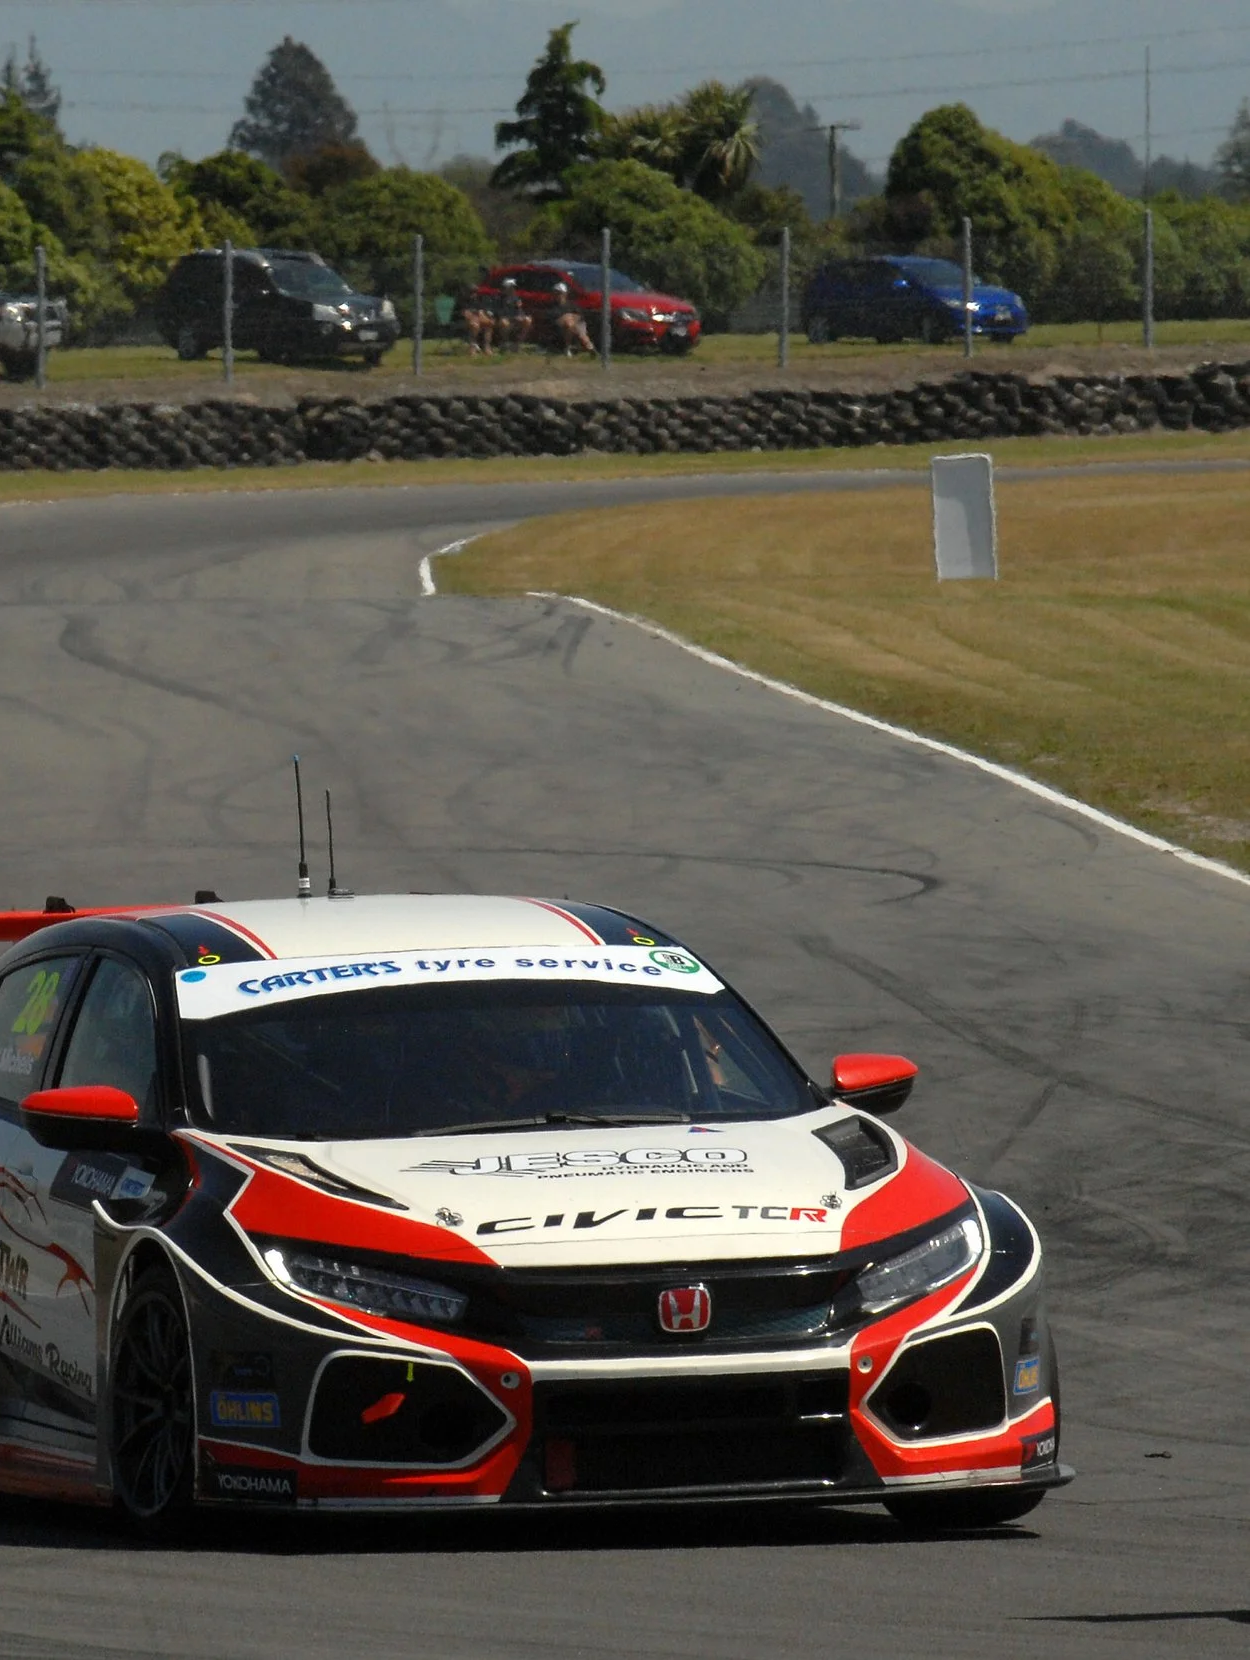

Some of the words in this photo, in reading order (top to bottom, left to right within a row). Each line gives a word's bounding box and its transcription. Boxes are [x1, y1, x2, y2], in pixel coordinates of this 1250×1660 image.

[237, 960, 402, 996] CARTER'S
[414, 957, 496, 972] tyre
[516, 957, 662, 977] service
[11, 969, 61, 1036] 28
[450, 1147, 748, 1175] JESCO
[536, 1170, 645, 1181] PNEUMATIC
[601, 1163, 704, 1171] HYDRAULIC
[476, 1206, 724, 1235] CIVIC
[731, 1205, 828, 1223] TCR
[45, 1342, 94, 1396] Racing
[218, 1474, 293, 1494] YOKOHAMA
